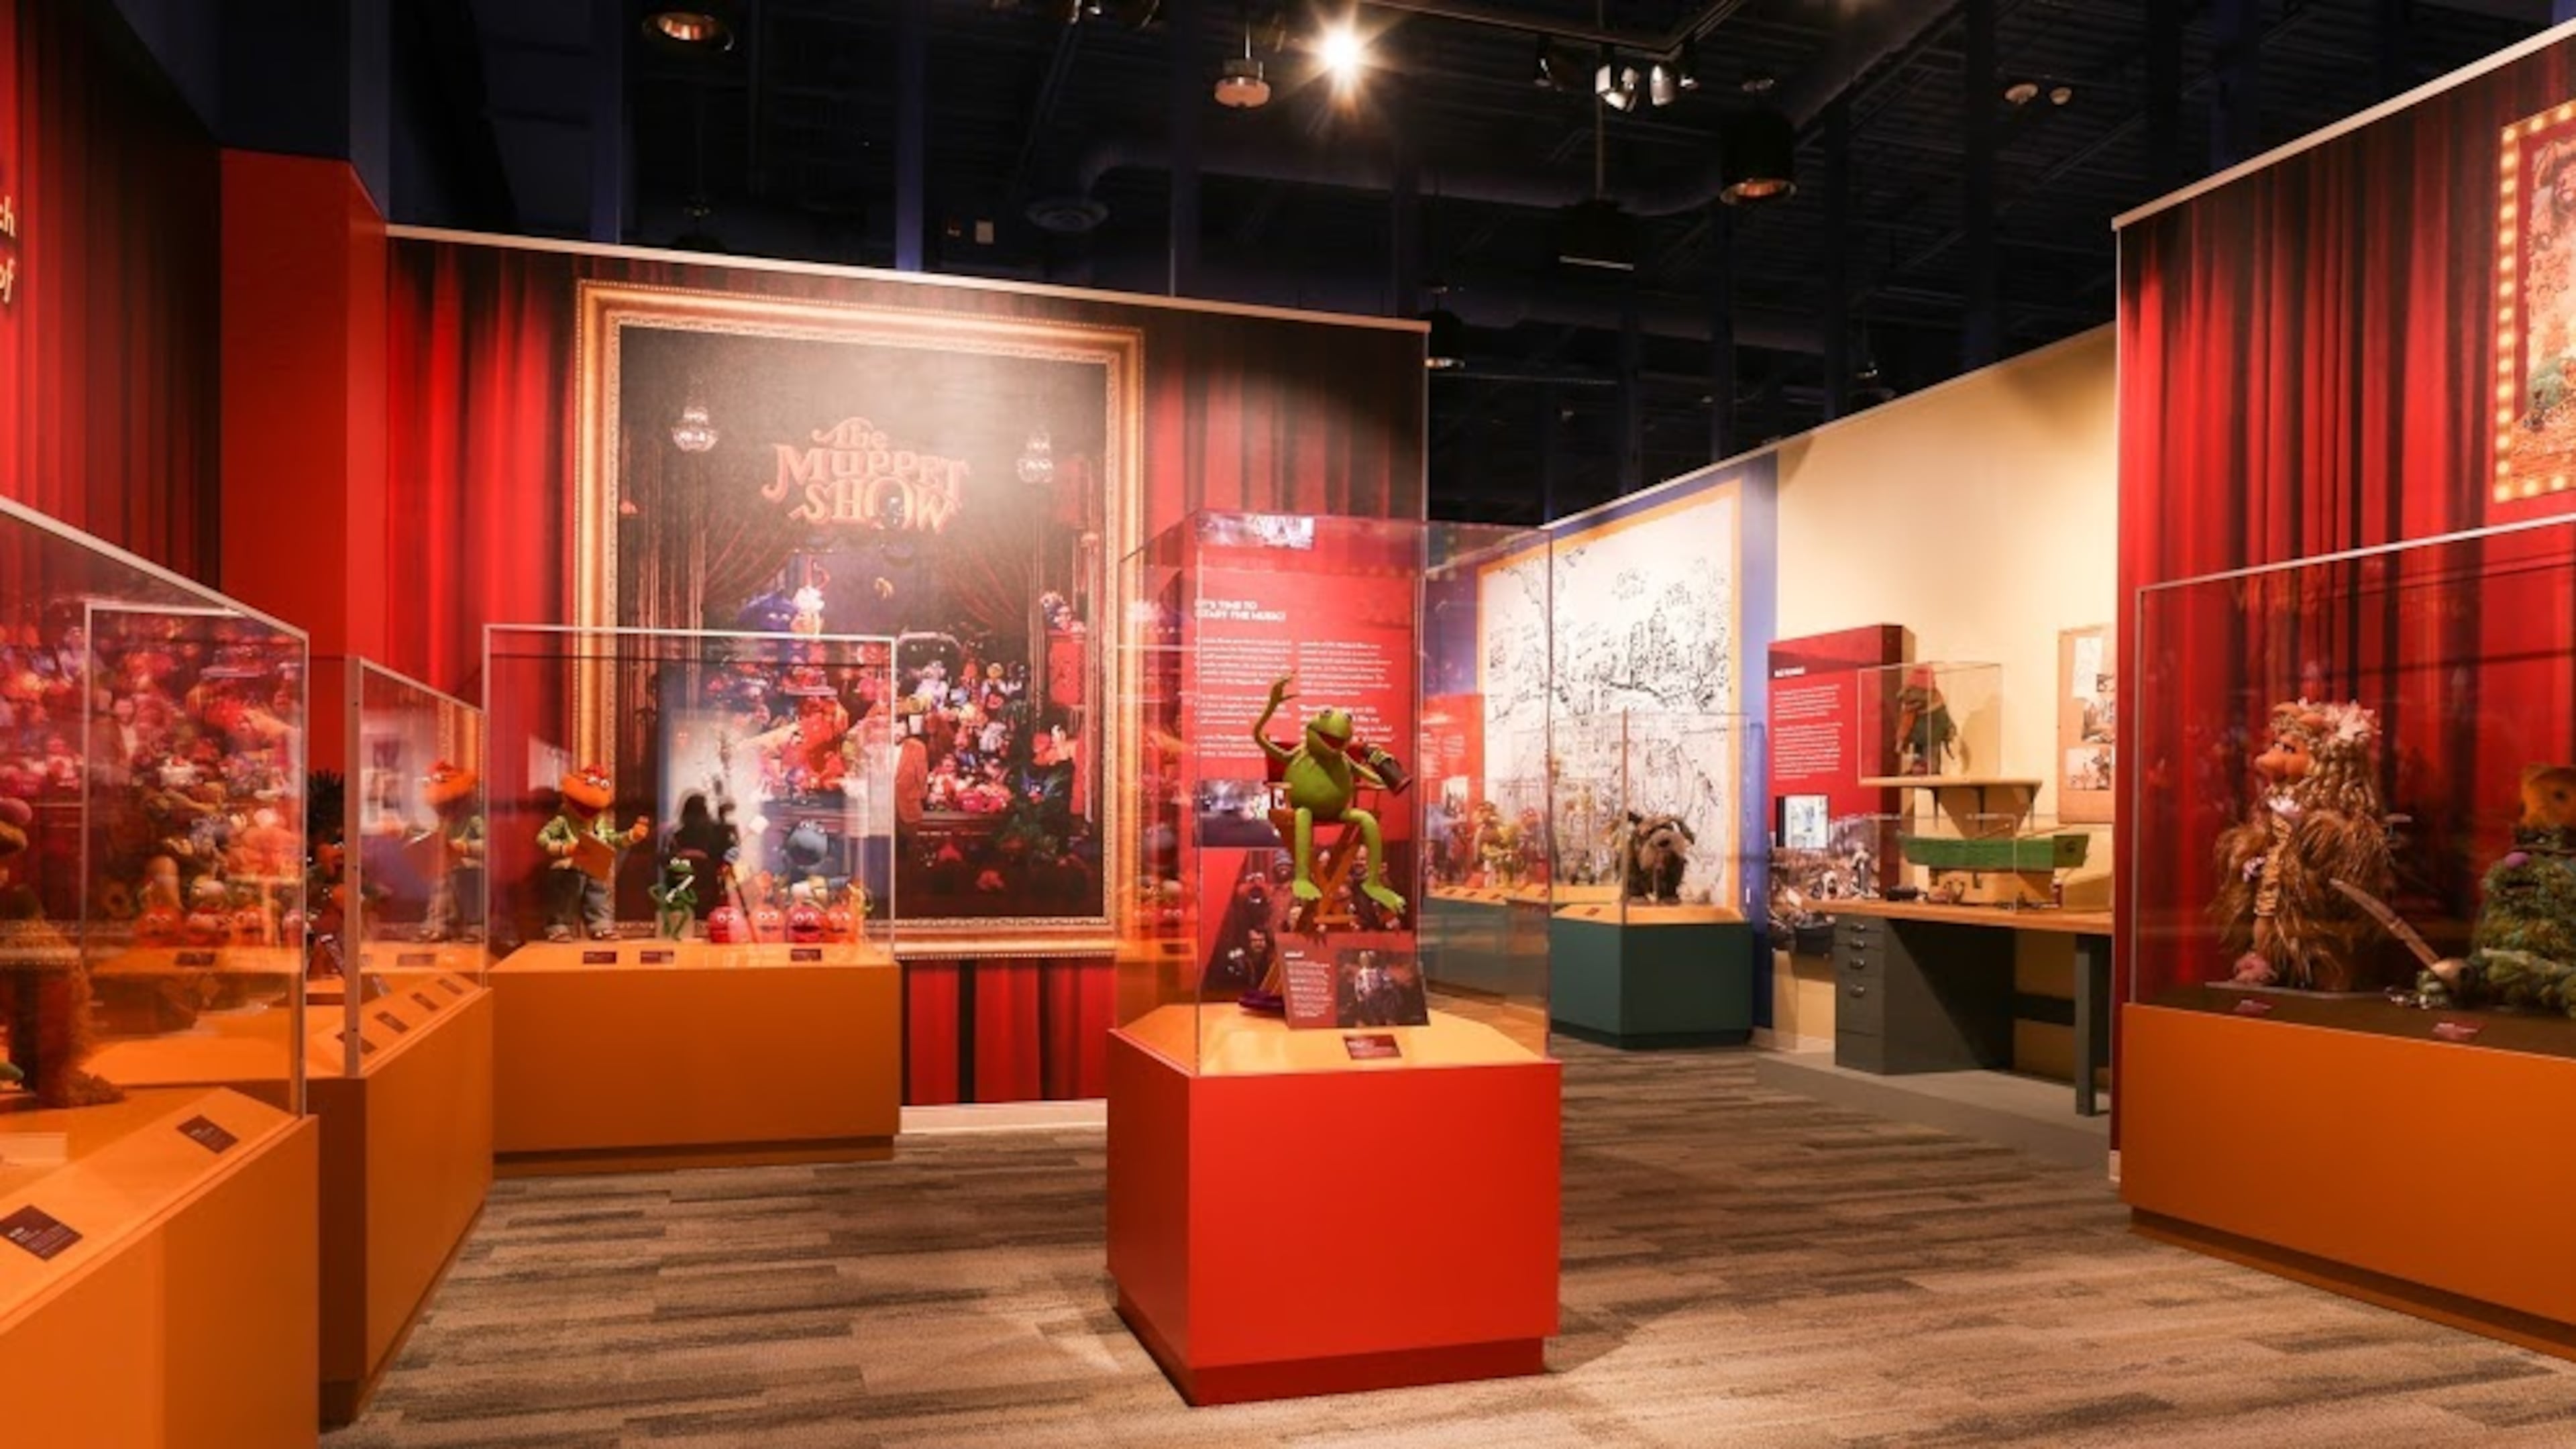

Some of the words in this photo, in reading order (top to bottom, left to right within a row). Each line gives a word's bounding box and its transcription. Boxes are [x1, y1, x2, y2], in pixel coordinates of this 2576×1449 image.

[811, 416, 889, 450] The
[761, 443, 970, 503] MUPPET
[788, 476, 961, 535] SHOW
